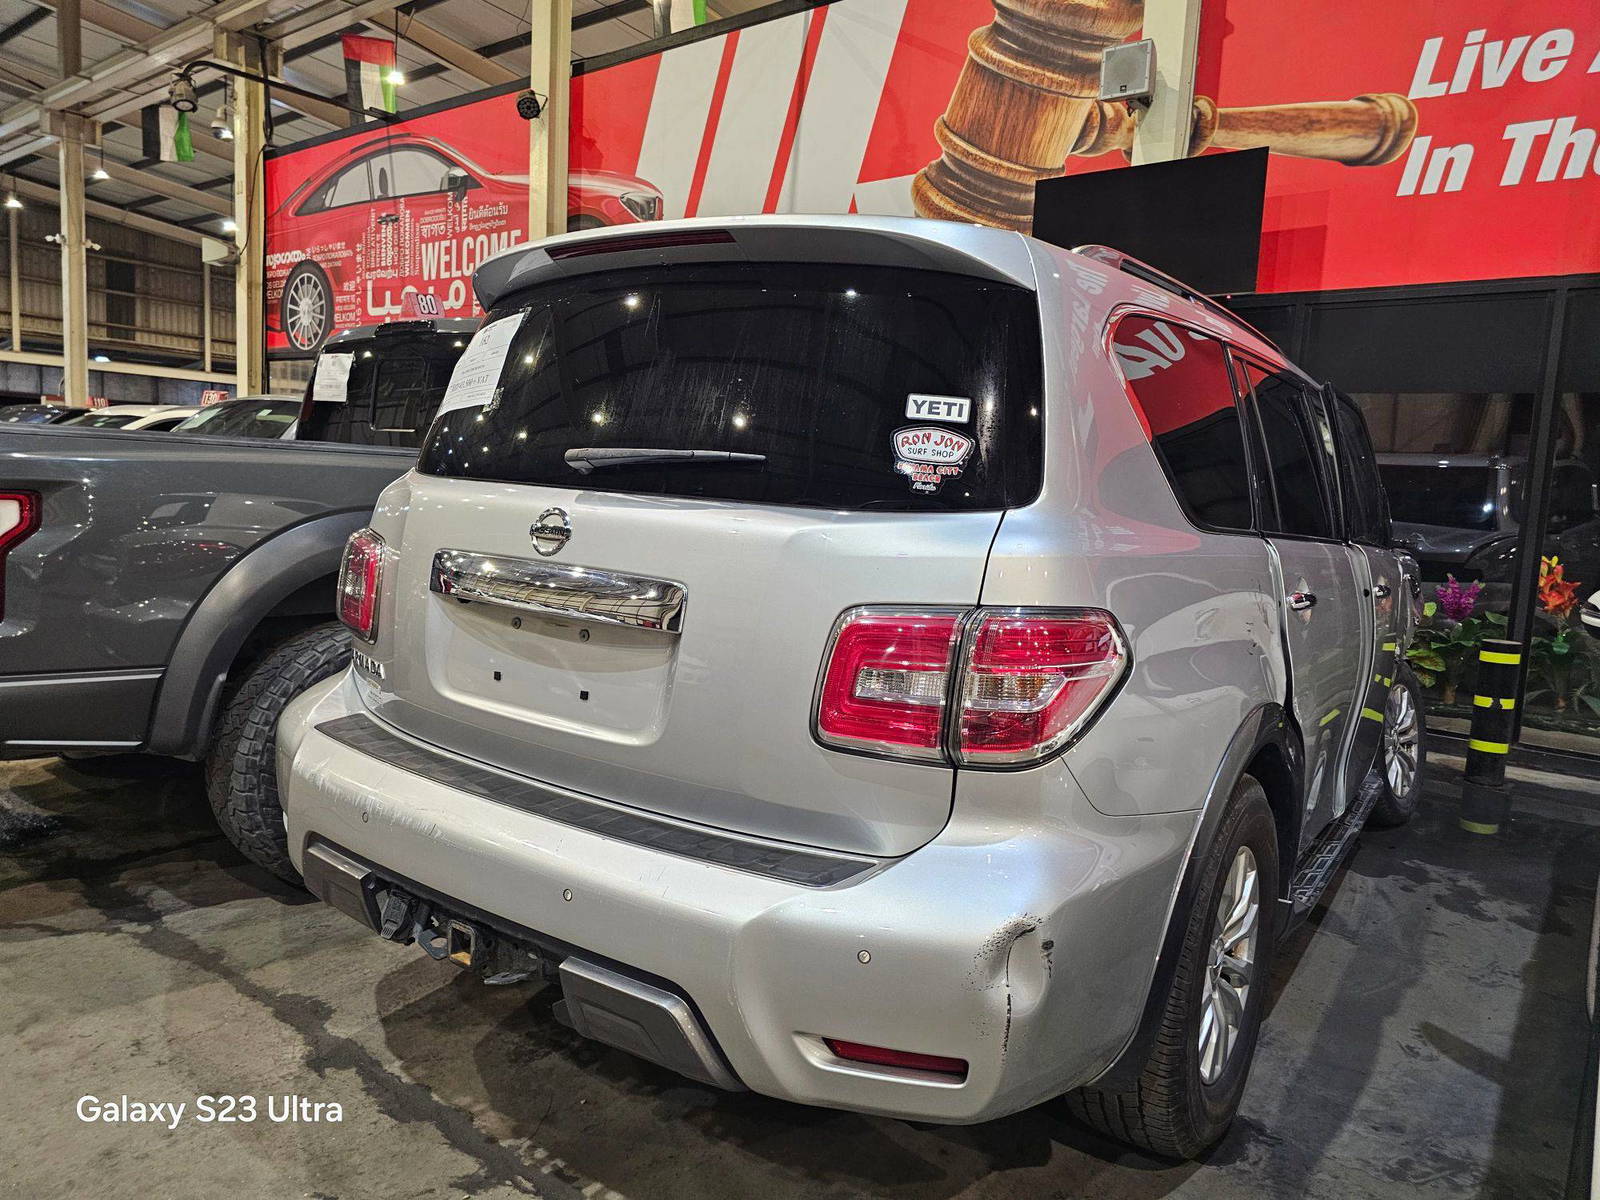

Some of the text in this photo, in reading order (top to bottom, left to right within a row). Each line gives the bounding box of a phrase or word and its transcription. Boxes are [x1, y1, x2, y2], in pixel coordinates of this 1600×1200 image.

[1407, 28, 1575, 100] Live
[1395, 116, 1600, 197] In Th
[417, 293, 438, 315] 80
[911, 398, 965, 418] YETI
[901, 432, 965, 452] RON JON
[907, 447, 955, 459] SURF SHOP
